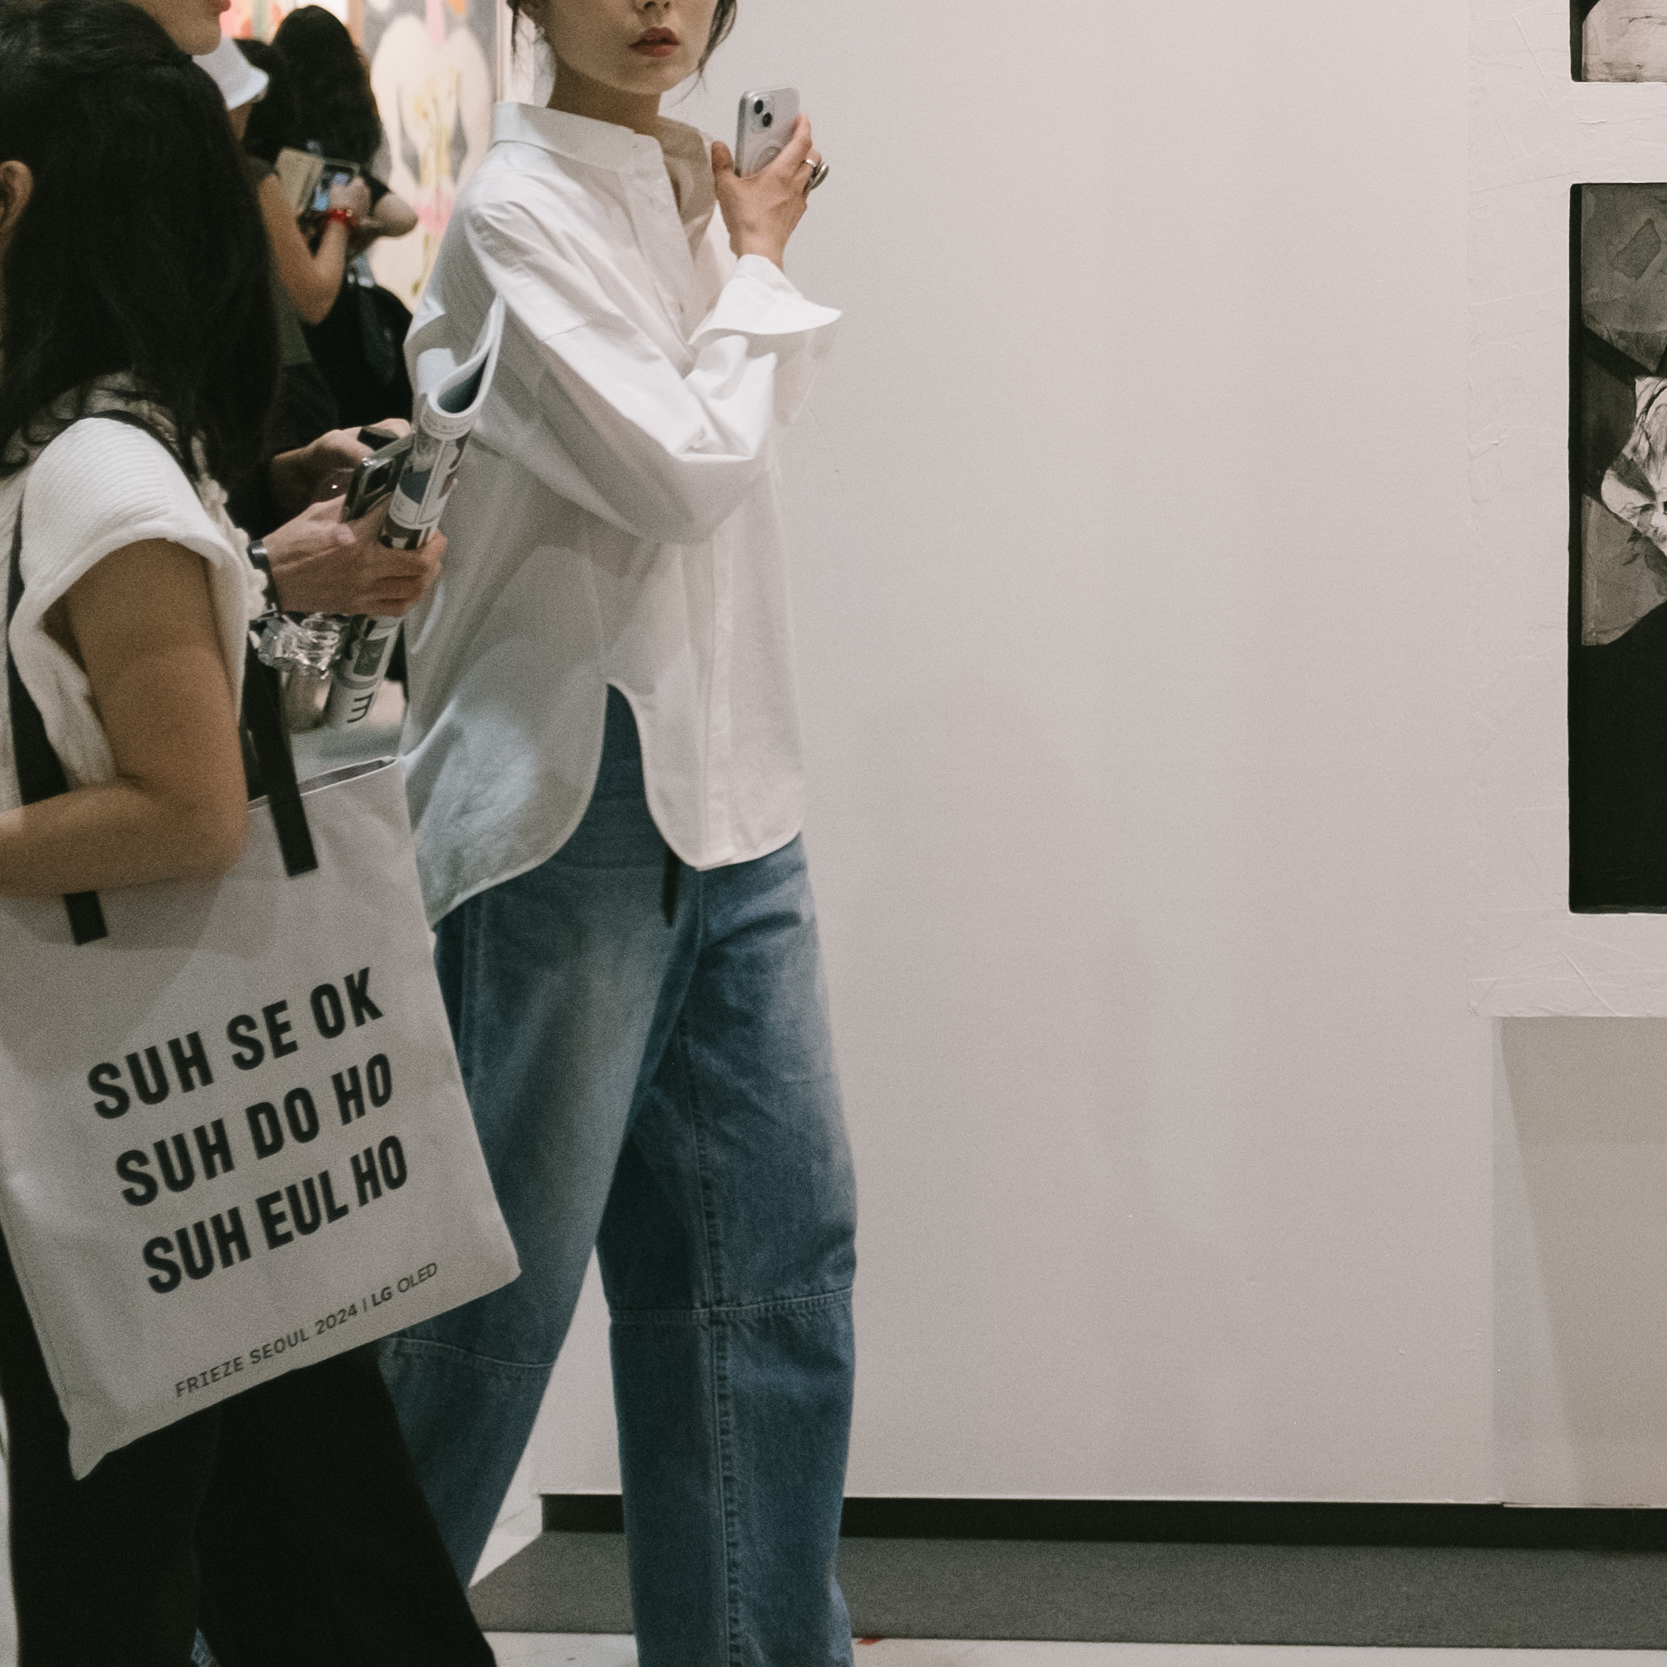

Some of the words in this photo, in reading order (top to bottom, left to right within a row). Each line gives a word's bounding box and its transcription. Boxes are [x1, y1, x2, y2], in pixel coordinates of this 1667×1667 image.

[88, 1031, 214, 1120] SUH
[227, 999, 299, 1071] SE
[310, 967, 383, 1039] OK
[115, 1118, 235, 1207] SUH
[245, 1087, 320, 1160] DO
[331, 1053, 393, 1125] HO
[142, 1206, 252, 1294] SUH
[256, 1170, 349, 1250] EUL
[350, 1135, 408, 1207] HO
[174, 1355, 244, 1398] FRIEZE
[249, 1327, 310, 1366] SEOUL
[315, 1303, 358, 1335] 2024
[371, 1285, 394, 1308] LG
[396, 1261, 438, 1293] OLED
